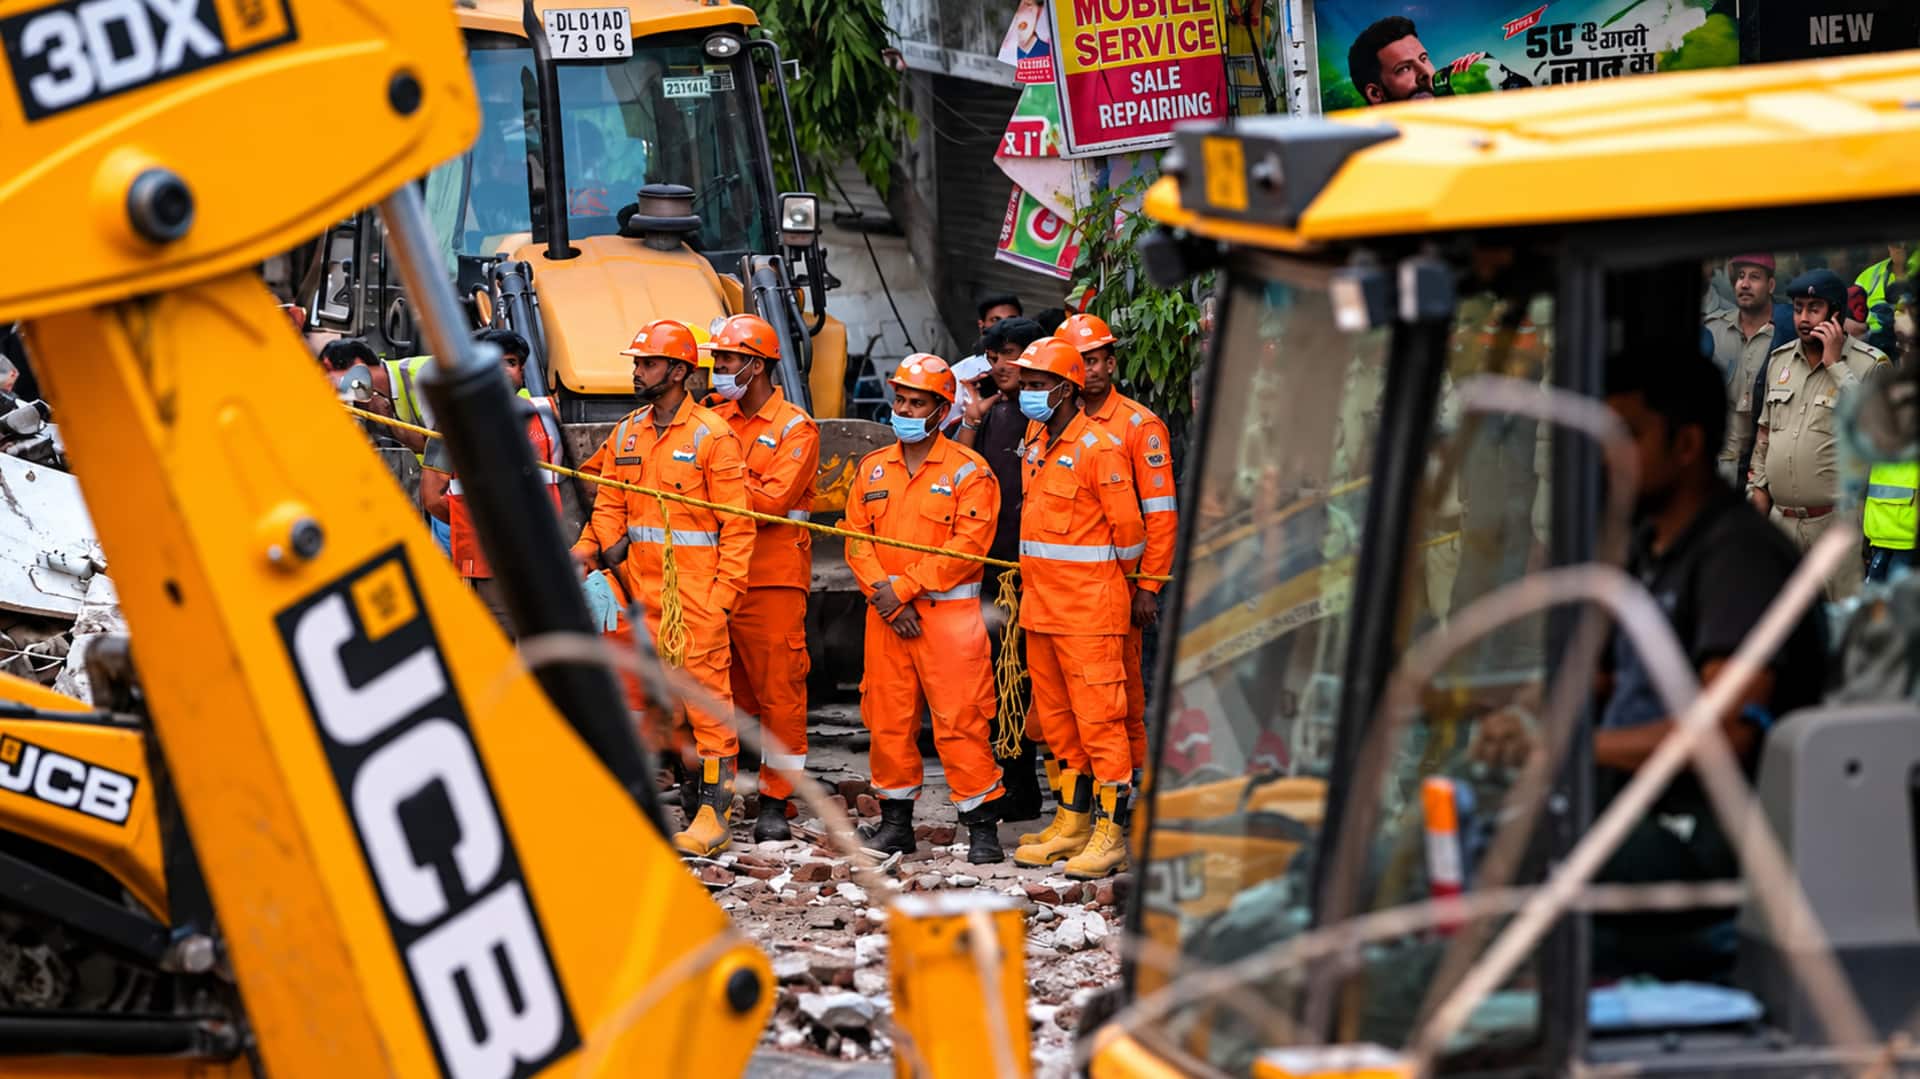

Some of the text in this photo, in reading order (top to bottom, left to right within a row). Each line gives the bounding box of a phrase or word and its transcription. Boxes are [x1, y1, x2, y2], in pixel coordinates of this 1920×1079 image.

[556, 11, 624, 32] DL01AD
[1075, 19, 1217, 67] SERVICE
[1809, 12, 1874, 46] NEW
[20, 0, 224, 109] 3DX
[1130, 65, 1182, 95] SALE
[0, 744, 134, 823] JCB
[293, 592, 564, 1079] JCB
